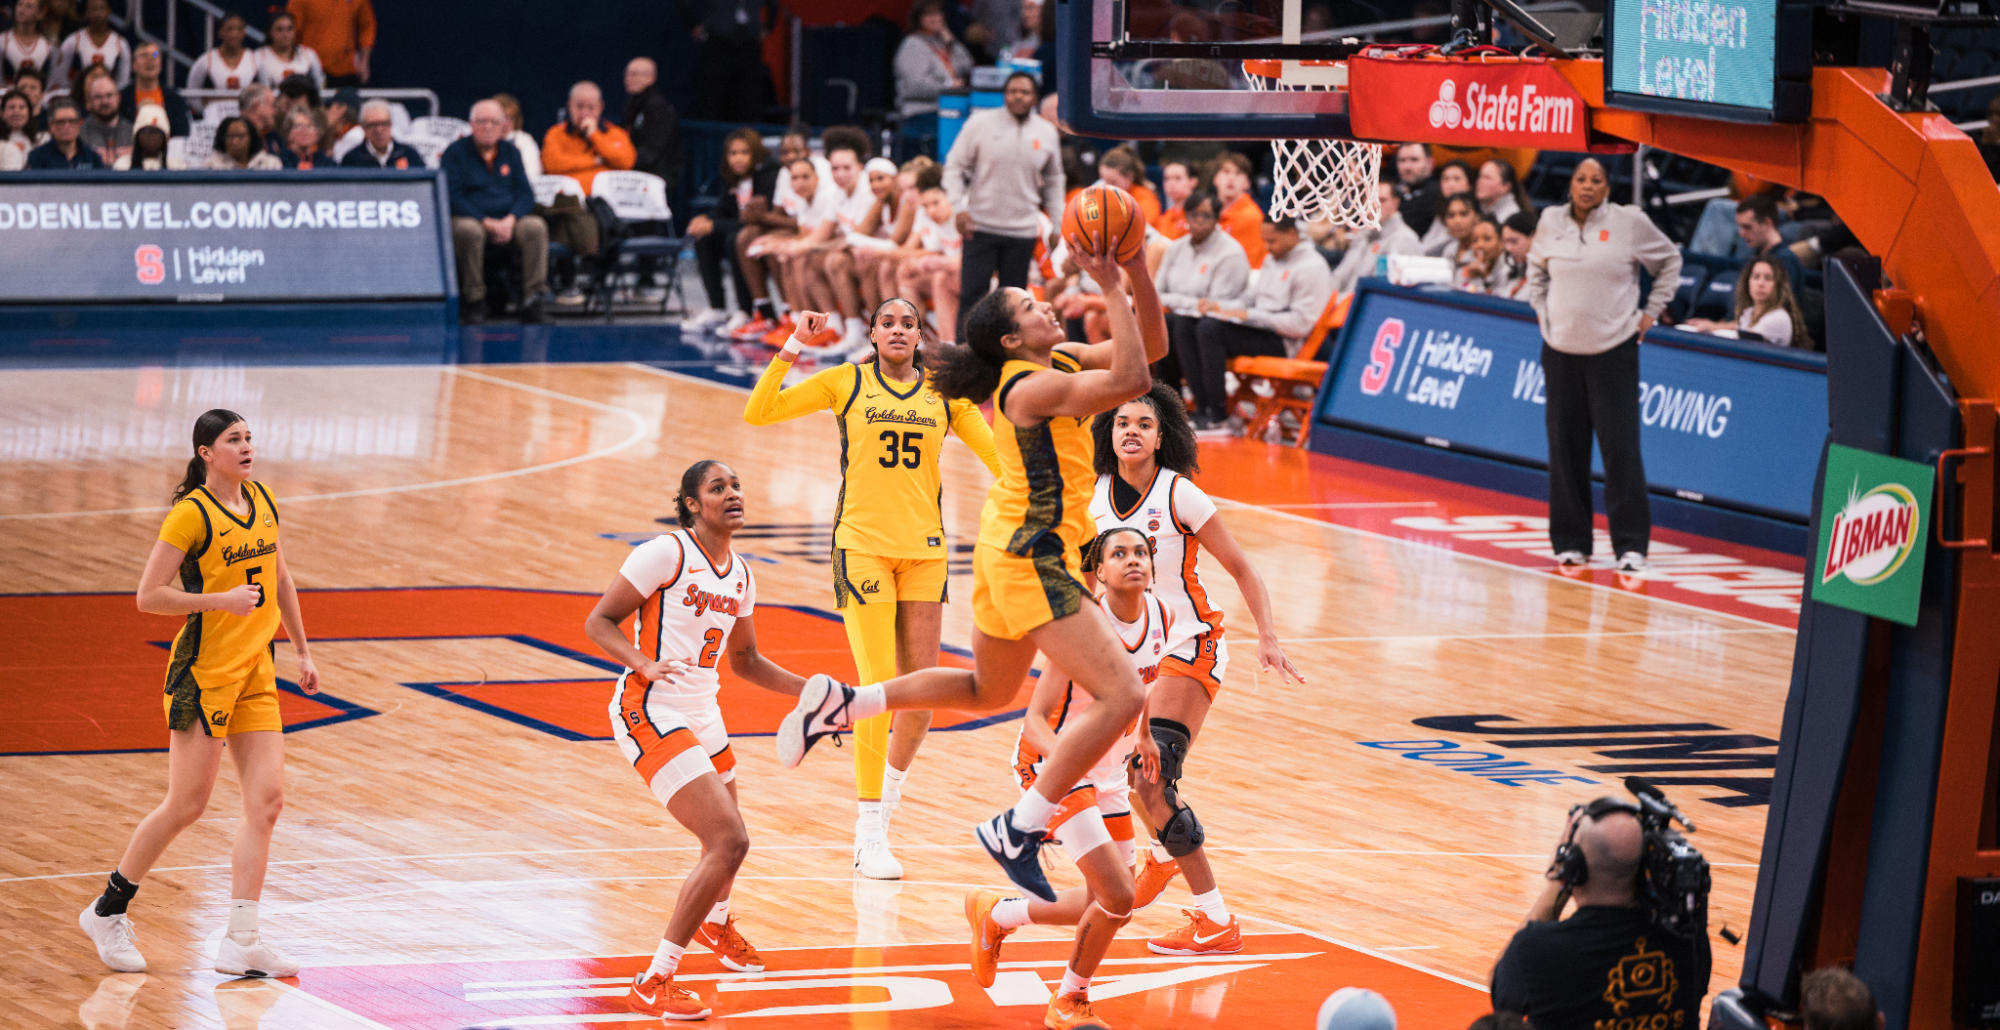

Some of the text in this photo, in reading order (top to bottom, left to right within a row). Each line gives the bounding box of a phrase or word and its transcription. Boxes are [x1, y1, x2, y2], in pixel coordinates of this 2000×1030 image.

[1639, 38, 1716, 103] Level
[188, 245, 265, 267] Hidden
[190, 263, 246, 284] Level
[1417, 329, 1493, 378] Hidden
[1406, 365, 1465, 410] Level
[865, 406, 905, 425] Golden
[879, 430, 923, 469] 35
[221, 542, 256, 567] Golden
[1823, 503, 1914, 583] LIBMAN
[246, 566, 266, 608] 5
[861, 579, 880, 594] Cal
[698, 627, 724, 668] 2
[211, 710, 229, 726] Cal
[1355, 739, 1602, 787] DOME
